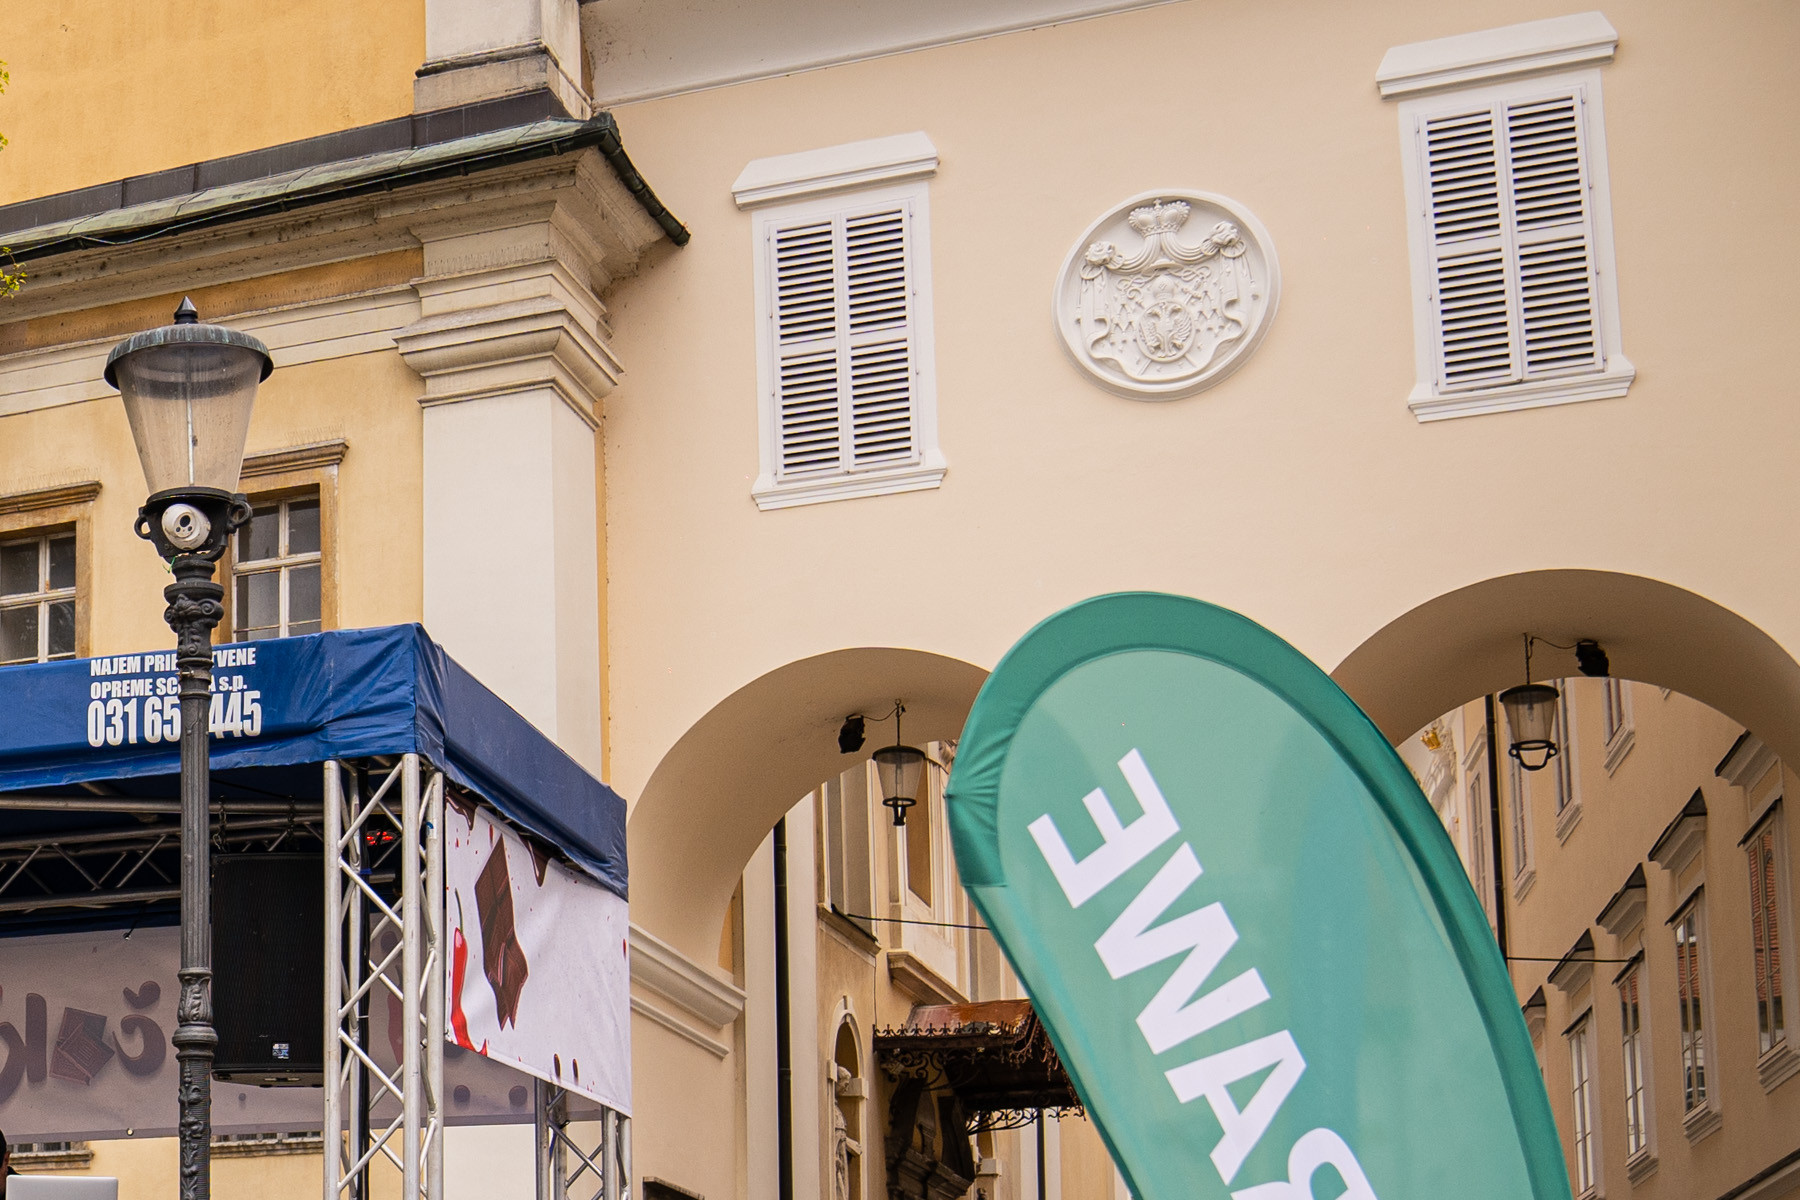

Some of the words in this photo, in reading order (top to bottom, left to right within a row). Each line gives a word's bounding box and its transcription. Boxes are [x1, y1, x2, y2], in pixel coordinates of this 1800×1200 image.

[91, 656, 141, 676] NAJEM
[91, 678, 153, 699] OPREME
[219, 674, 248, 692] s.p.
[87, 698, 137, 747] 031
[144, 695, 182, 743] 65
